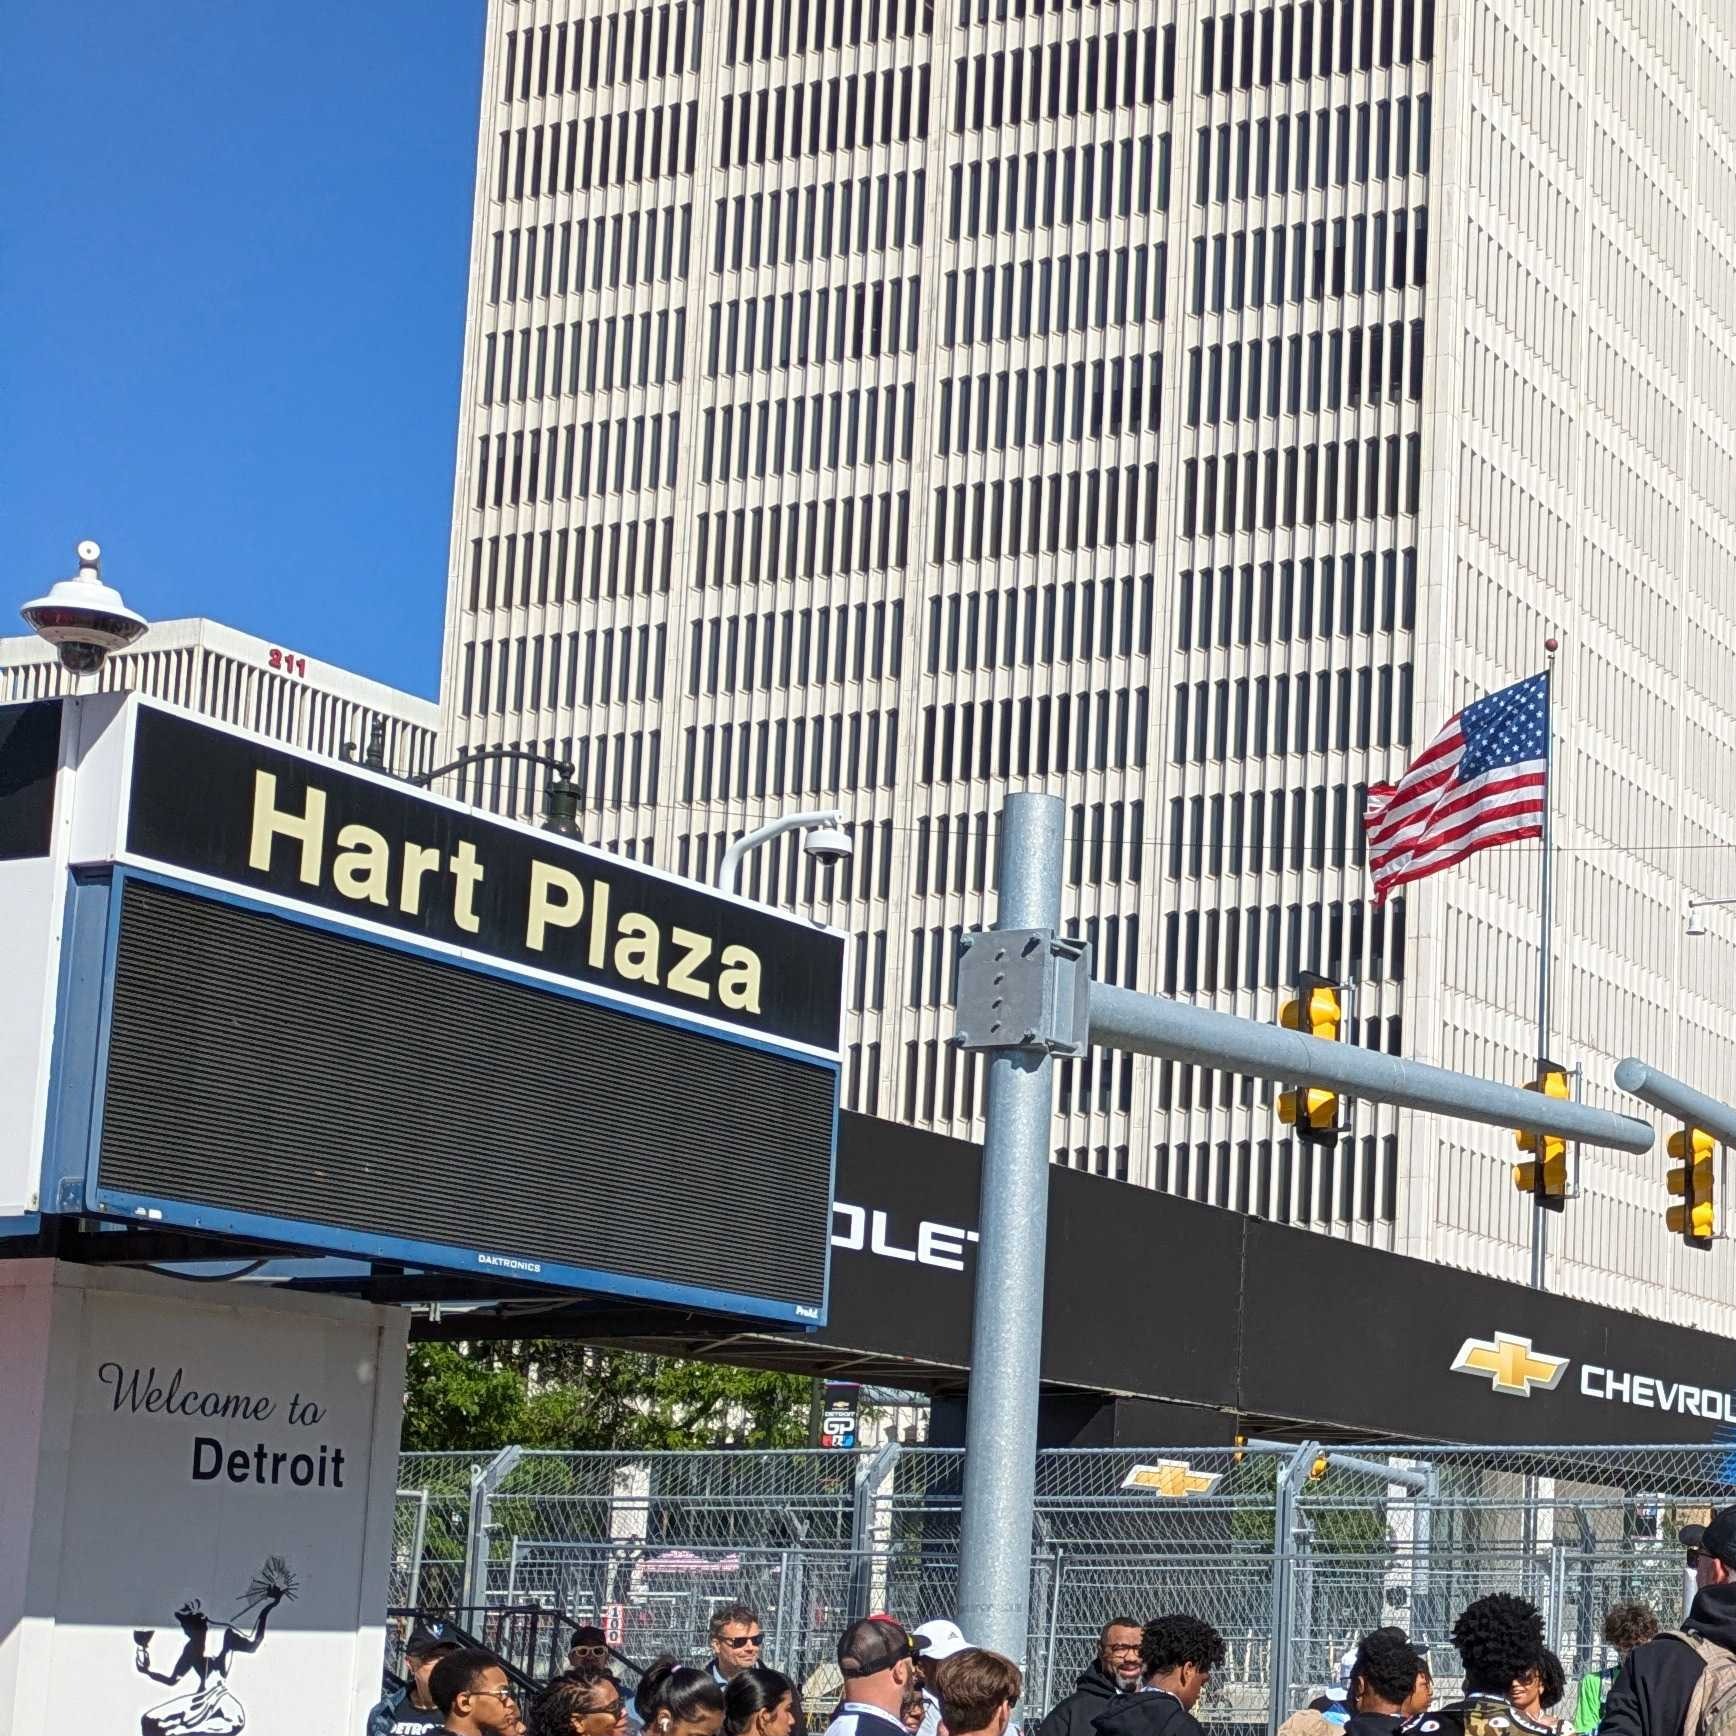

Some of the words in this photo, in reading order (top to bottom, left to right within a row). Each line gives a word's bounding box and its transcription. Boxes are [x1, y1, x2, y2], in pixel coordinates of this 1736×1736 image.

[267, 648, 306, 678] 211
[249, 768, 484, 934] Hart
[525, 858, 762, 1016] Plaza
[478, 1254, 541, 1273] DAKTRONICS
[831, 1201, 980, 1271] OLE
[98, 1362, 277, 1421] Welcome
[287, 1393, 327, 1426] to
[192, 1436, 345, 1488] Detroit
